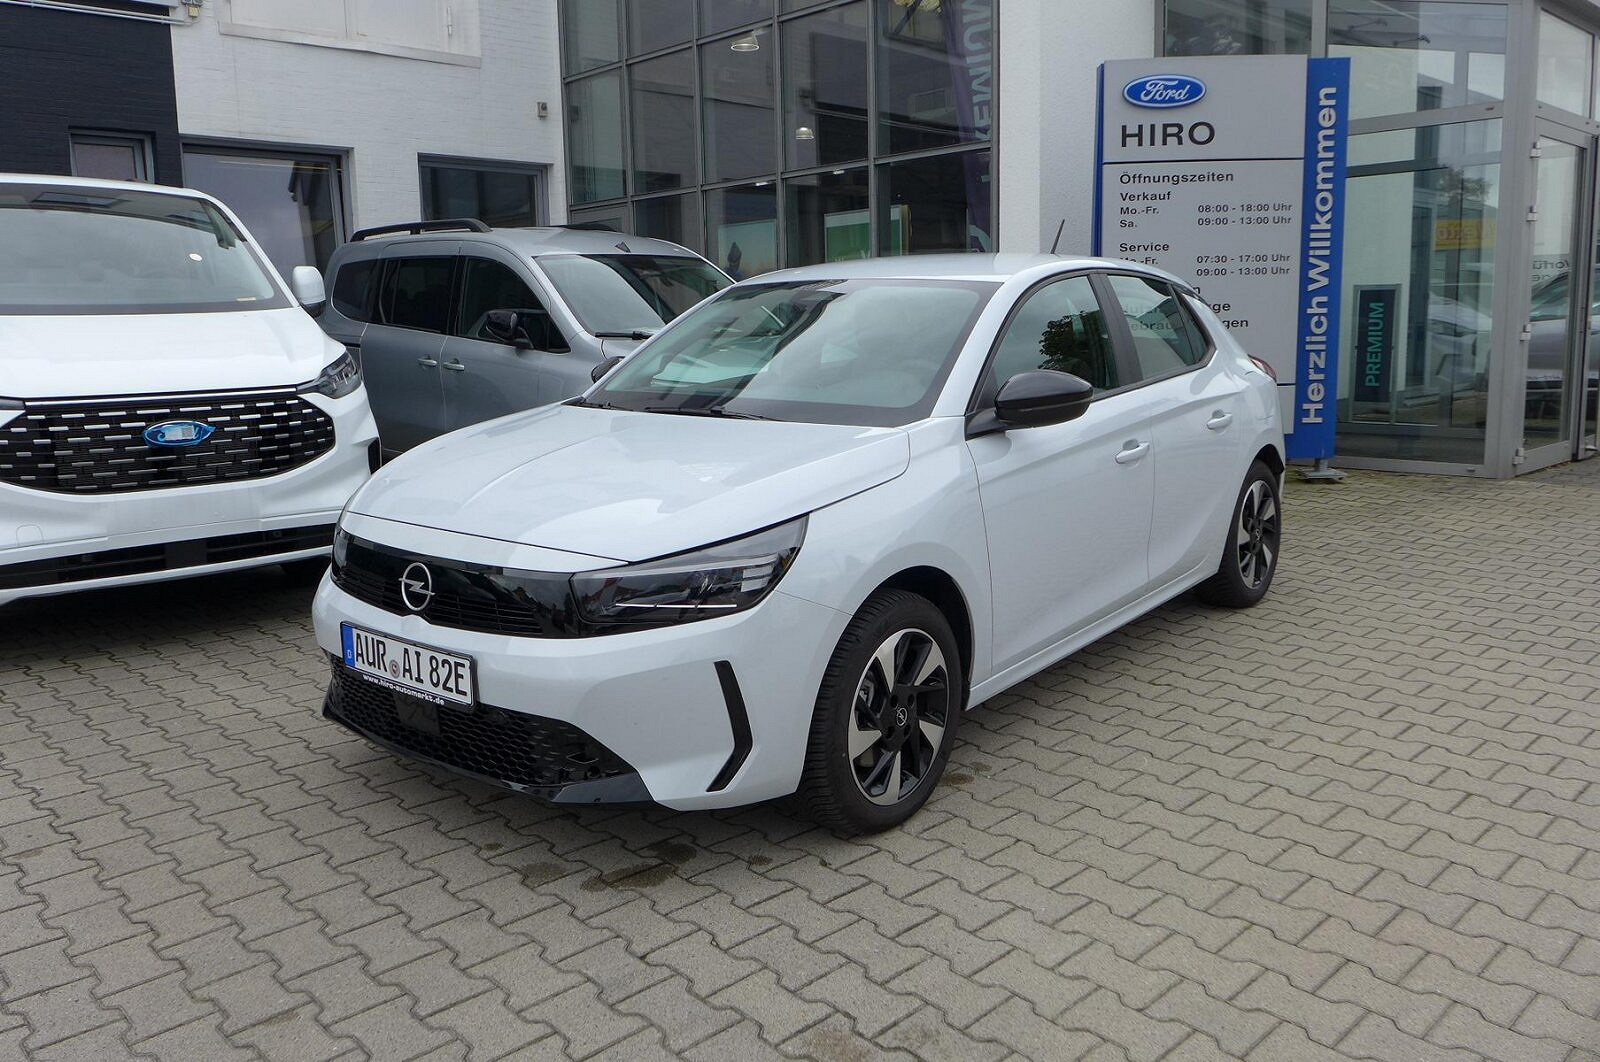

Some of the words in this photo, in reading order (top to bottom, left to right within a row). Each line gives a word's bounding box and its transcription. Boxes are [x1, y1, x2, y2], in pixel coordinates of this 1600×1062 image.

[1140, 80, 1190, 101] Ford
[1121, 121, 1216, 148] HIRO
[1119, 171, 1234, 186] Öffnungszeiten
[1120, 191, 1171, 202] Verkauf
[1307, 86, 1337, 293] Willkommen
[1120, 206, 1160, 215] Mo.-Fr.
[1197, 204, 1229, 213] 08:00
[1240, 203, 1270, 212] 18:00
[1273, 203, 1292, 212] Uhr
[1119, 219, 1138, 228] Sa.
[1197, 217, 1229, 226] 09:00
[1240, 216, 1269, 225] 13:00
[1272, 215, 1292, 224] Uhr
[1119, 242, 1170, 252] Service
[1196, 255, 1228, 264] 07:30
[1239, 254, 1268, 263] 17:00
[1271, 253, 1290, 262] Uhr
[1196, 267, 1227, 276] 09:00
[1238, 266, 1268, 275] 13:00
[1271, 266, 1290, 275] Uhr
[1365, 301, 1385, 387] PREMIUM
[1301, 295, 1329, 424] Herzlich
[355, 632, 388, 672] AUR
[402, 647, 424, 684] AI
[429, 655, 468, 696] 82E
[362, 674, 445, 706] www.hiro-automarkt.de
